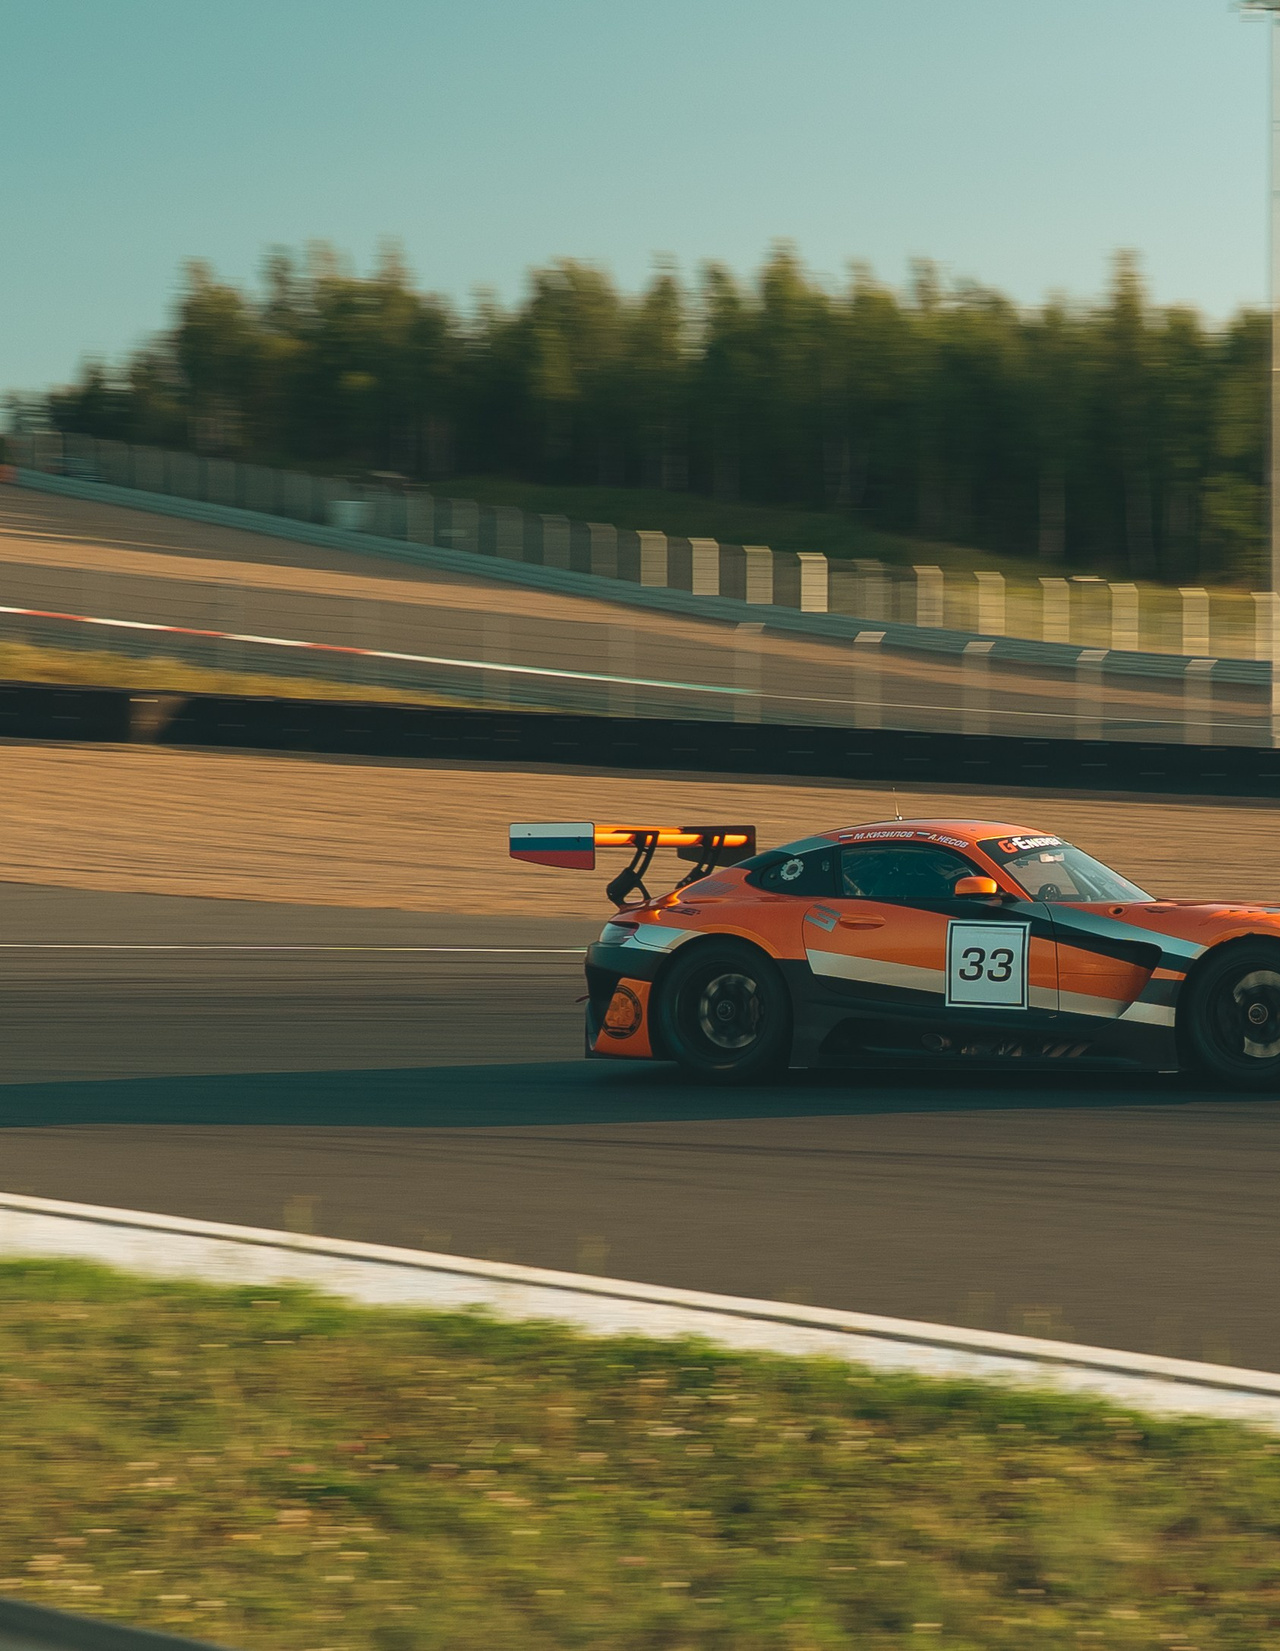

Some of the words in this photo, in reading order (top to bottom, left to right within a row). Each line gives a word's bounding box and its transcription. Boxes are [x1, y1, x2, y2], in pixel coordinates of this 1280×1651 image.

[854, 831, 915, 840] М.КИЗИЛОВ
[927, 834, 970, 849] А.НЕСОВ
[958, 947, 1015, 982] 33
